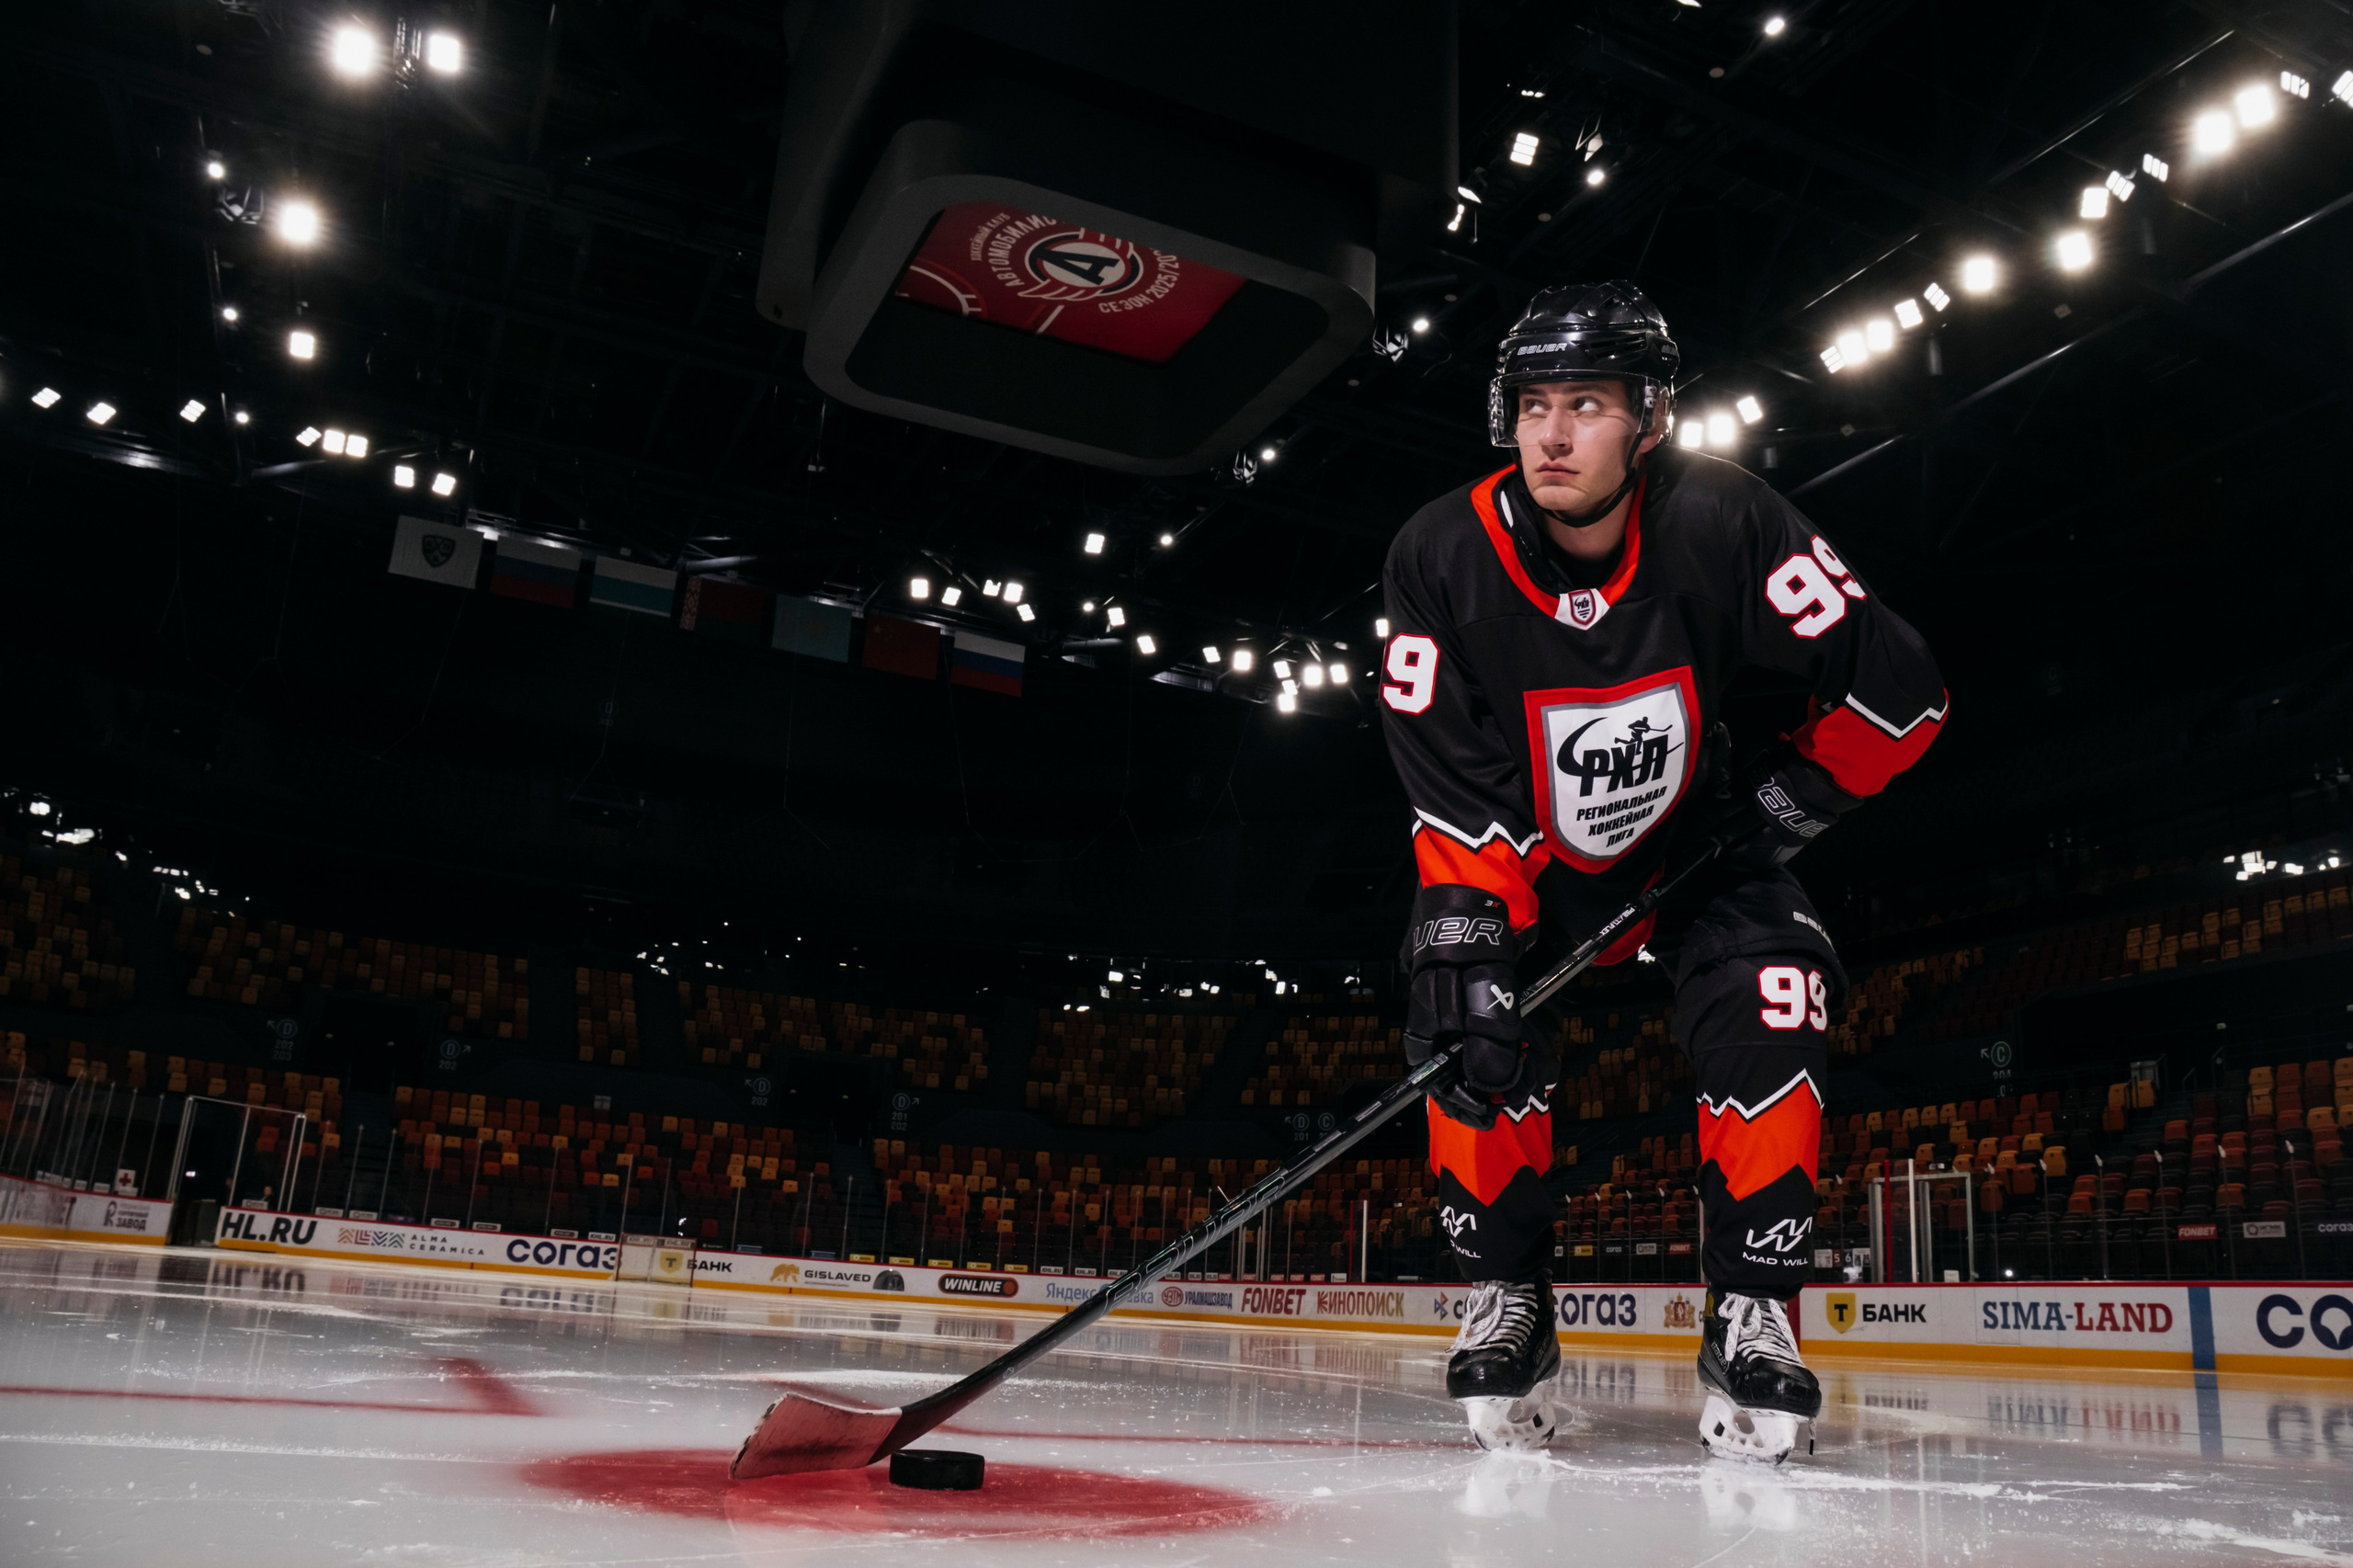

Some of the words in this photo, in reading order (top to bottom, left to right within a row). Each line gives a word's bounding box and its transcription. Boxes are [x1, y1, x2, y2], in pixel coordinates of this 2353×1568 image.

[987, 212, 1012, 229] КЛУБ
[988, 214, 1057, 288] АВТОМОБИЛИС
[1098, 294, 1154, 314] СЕЗОН
[1764, 534, 1868, 640] 99
[1381, 632, 1441, 716] 9
[1575, 786, 1667, 822] РЕГИОНАЛЬНАЯ
[1587, 804, 1654, 837] ХОККЕЙНАЯ
[1605, 827, 1635, 848] ЛИГА
[1756, 965, 1828, 1033] 99
[751, 1096, 768, 1107] 202
[892, 1111, 908, 1121] 201
[1294, 1132, 1309, 1142] 201
[116, 1218, 146, 1232] ЗАВОД
[2178, 1226, 2216, 1237] FONBET
[411, 1234, 449, 1244] ALMA
[410, 1244, 485, 1256] CERAMICA
[1455, 1244, 1482, 1258] WILL
[1834, 1253, 1840, 1263] 5
[1845, 1253, 1852, 1263] 6
[687, 1259, 733, 1273] БАНК
[1743, 1251, 1779, 1266] MAD
[1782, 1257, 1809, 1267] WILL
[804, 1270, 871, 1282] GISLAVED
[944, 1278, 1003, 1293] WINLINE
[1045, 1282, 1097, 1301] Яндекс
[1127, 1290, 1154, 1304] вка
[1184, 1291, 1233, 1309] УРАЛМАШЗАВОД
[1241, 1288, 1307, 1315] FONBET
[1316, 1290, 1404, 1317] КИНОПОИСК
[1862, 1303, 1927, 1323] БАНК
[1983, 1301, 2173, 1334] SIMA-LAND
